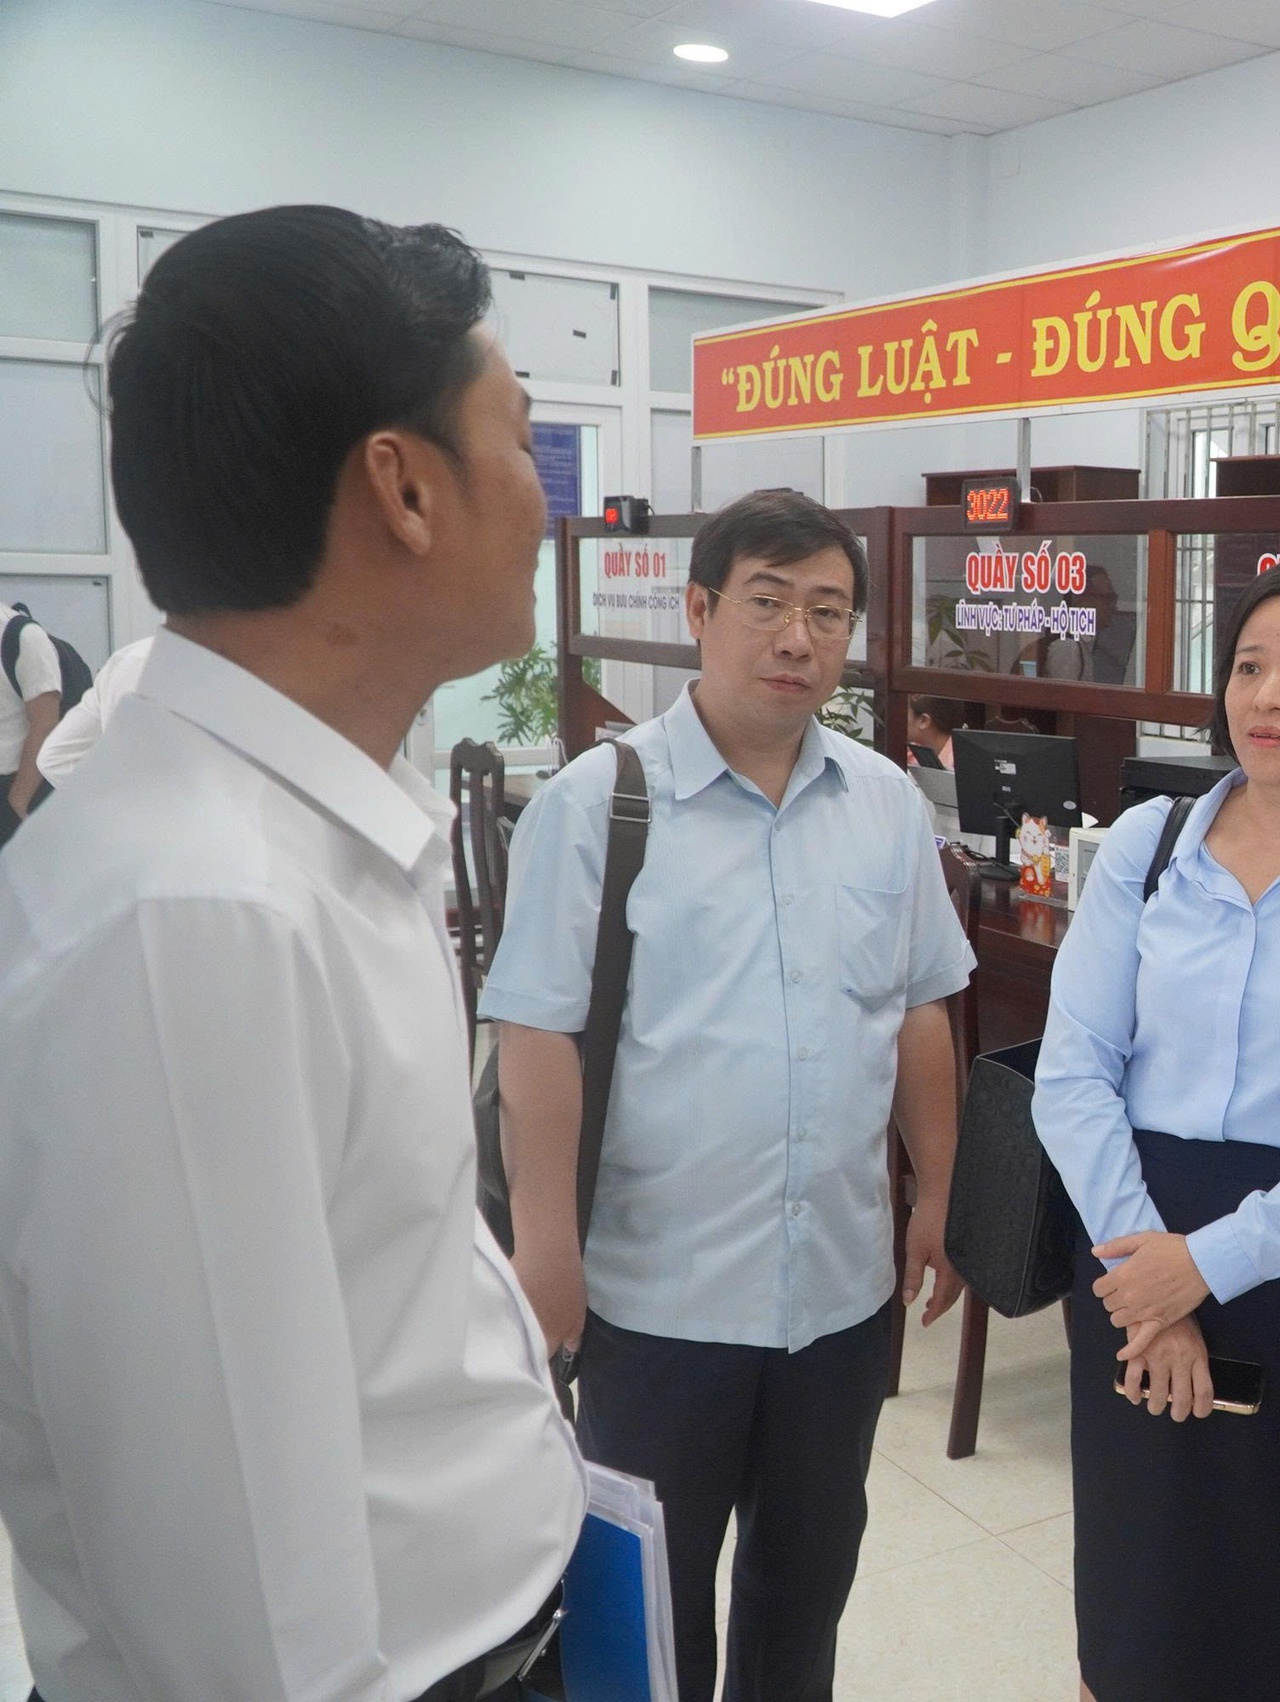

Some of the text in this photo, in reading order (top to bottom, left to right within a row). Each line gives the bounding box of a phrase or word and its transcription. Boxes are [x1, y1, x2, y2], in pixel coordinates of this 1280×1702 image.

[721, 344, 844, 413] “ĐÚNG
[856, 318, 979, 404] LUẬT
[996, 352, 1013, 364] -
[1030, 290, 1206, 377] ĐÚNG
[966, 488, 1010, 522] 3022
[604, 542, 666, 579] QUẦY SỐ 01
[967, 540, 1087, 593] QUẦY SỐ 03
[956, 599, 978, 630] LĨNH
[979, 602, 1002, 636] VỰC:
[1003, 602, 1017, 631] TƯ
[1017, 598, 1045, 632] PHÁP
[1051, 601, 1069, 640] HỘ
[1069, 606, 1096, 641] TỊCH
